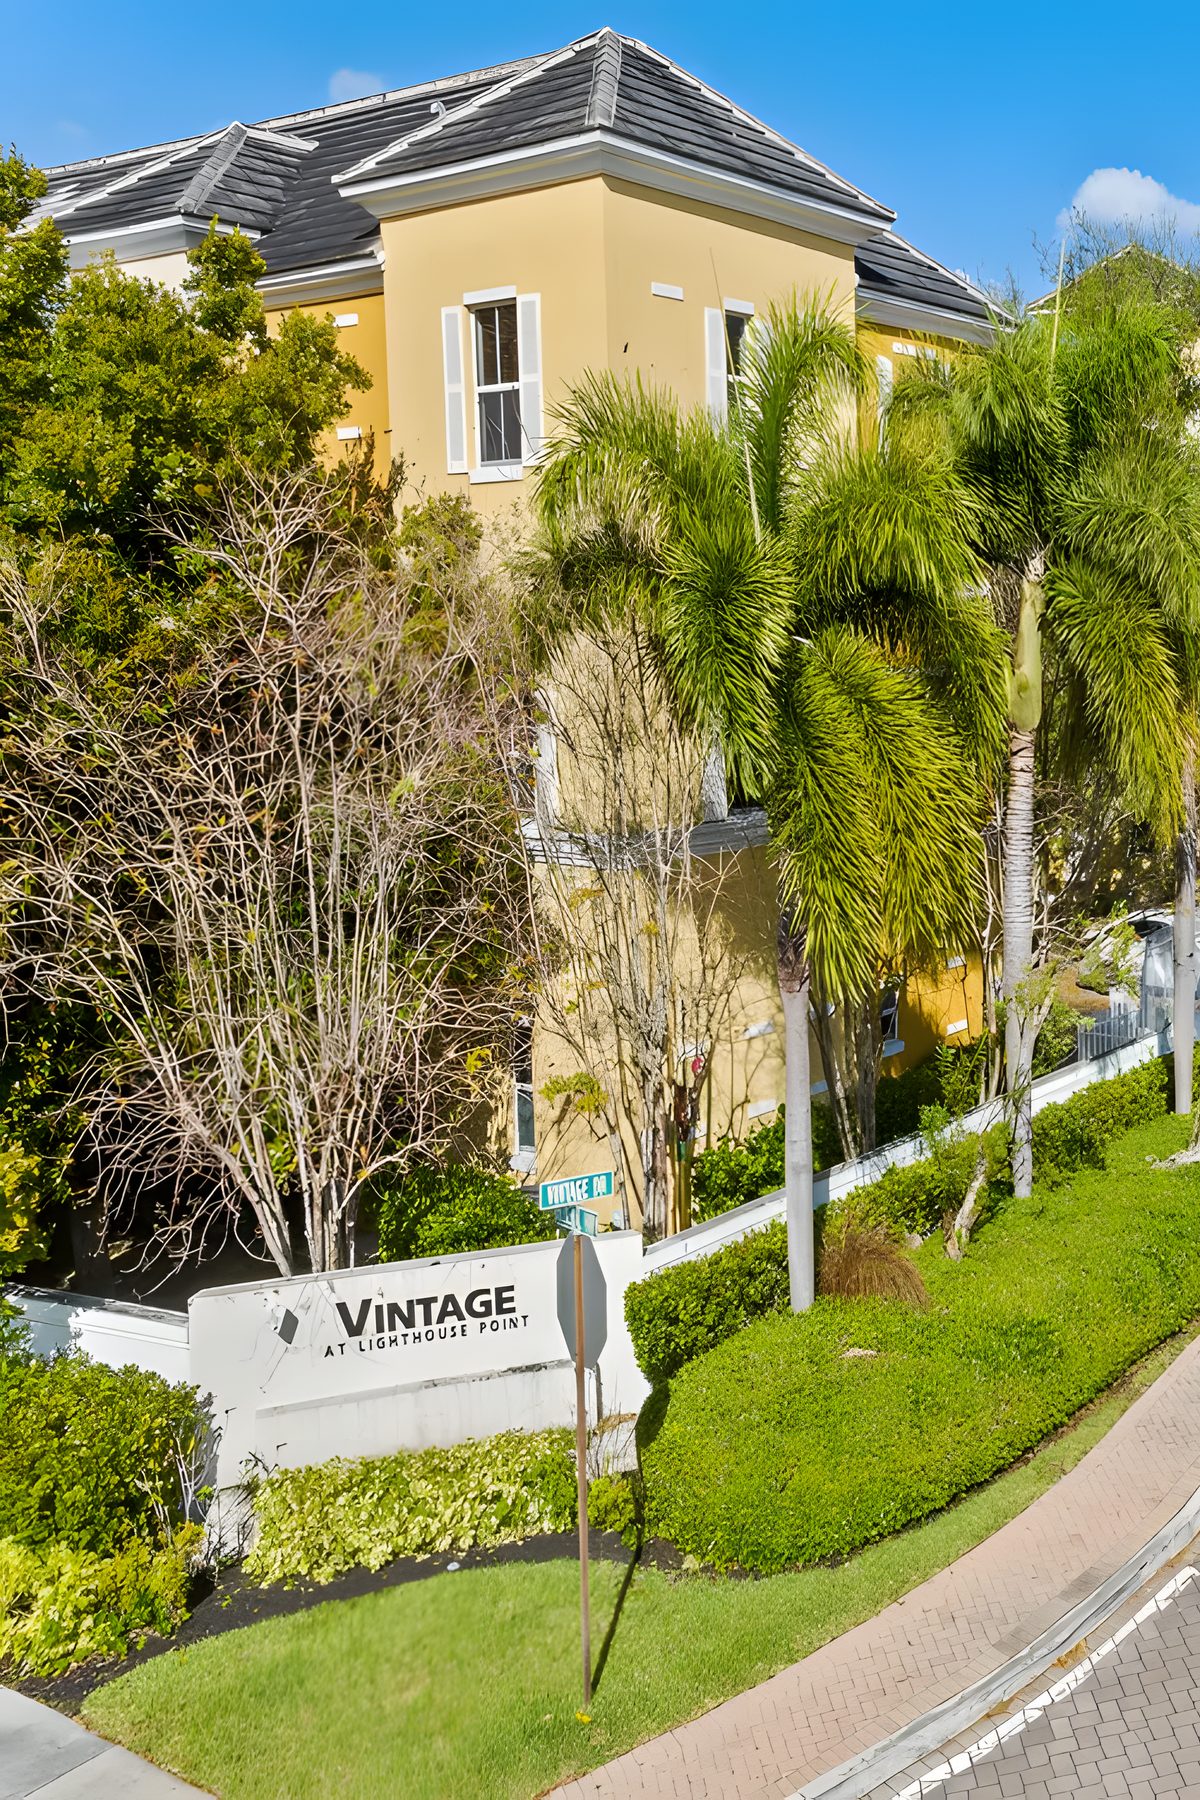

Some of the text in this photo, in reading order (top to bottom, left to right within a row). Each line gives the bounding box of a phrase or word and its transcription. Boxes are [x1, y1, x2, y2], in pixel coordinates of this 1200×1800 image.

[324, 1314, 530, 1358] AT LIGHTHOUSE POINT
